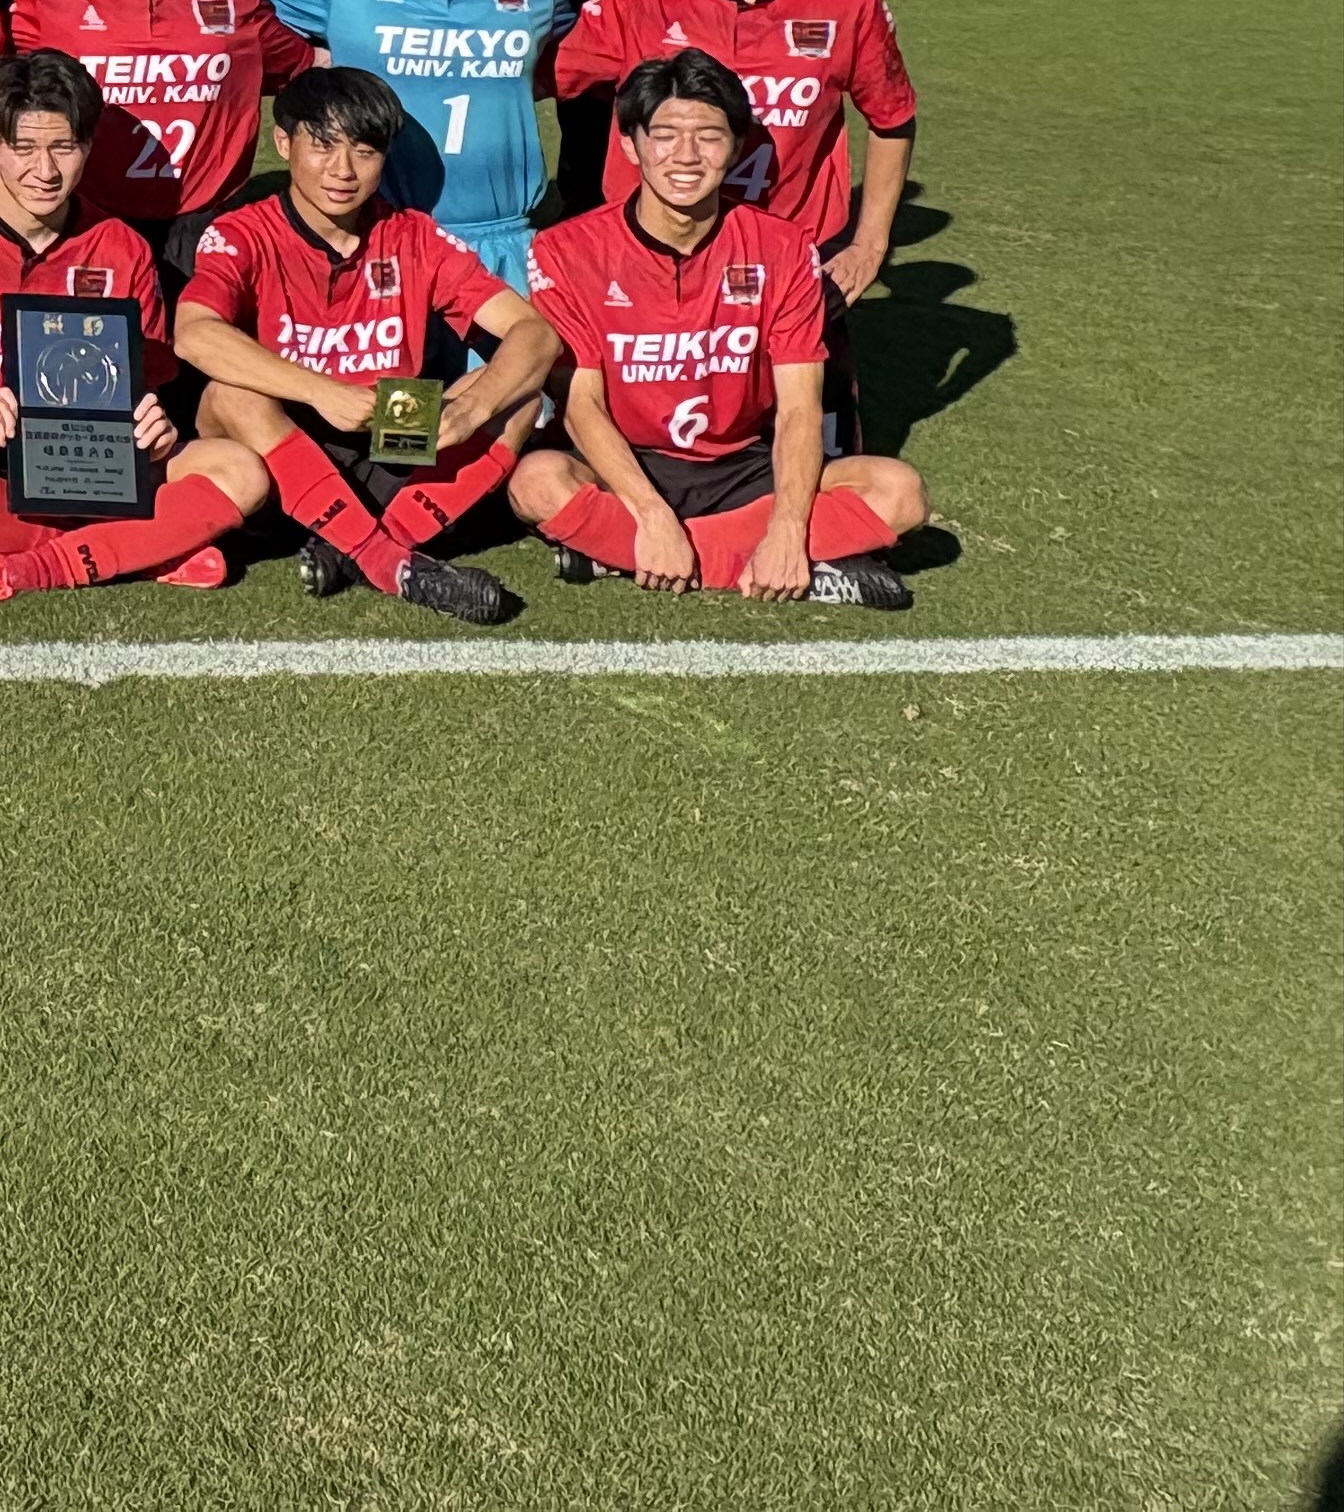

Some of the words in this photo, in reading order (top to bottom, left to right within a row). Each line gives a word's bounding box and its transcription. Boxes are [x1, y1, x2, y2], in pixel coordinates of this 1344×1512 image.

[374, 26, 531, 58] TEIKYO
[80, 53, 231, 83] TEIKYO
[387, 57, 454, 77] UNIV.
[462, 59, 523, 79] KANI
[165, 84, 221, 102] KANI
[443, 94, 471, 155] 1
[126, 119, 196, 178] 22
[607, 326, 758, 362] TEIKYO
[340, 350, 400, 372] KANI
[623, 363, 688, 383] UNIV.
[696, 356, 749, 379] KANI
[668, 395, 709, 449] 6
